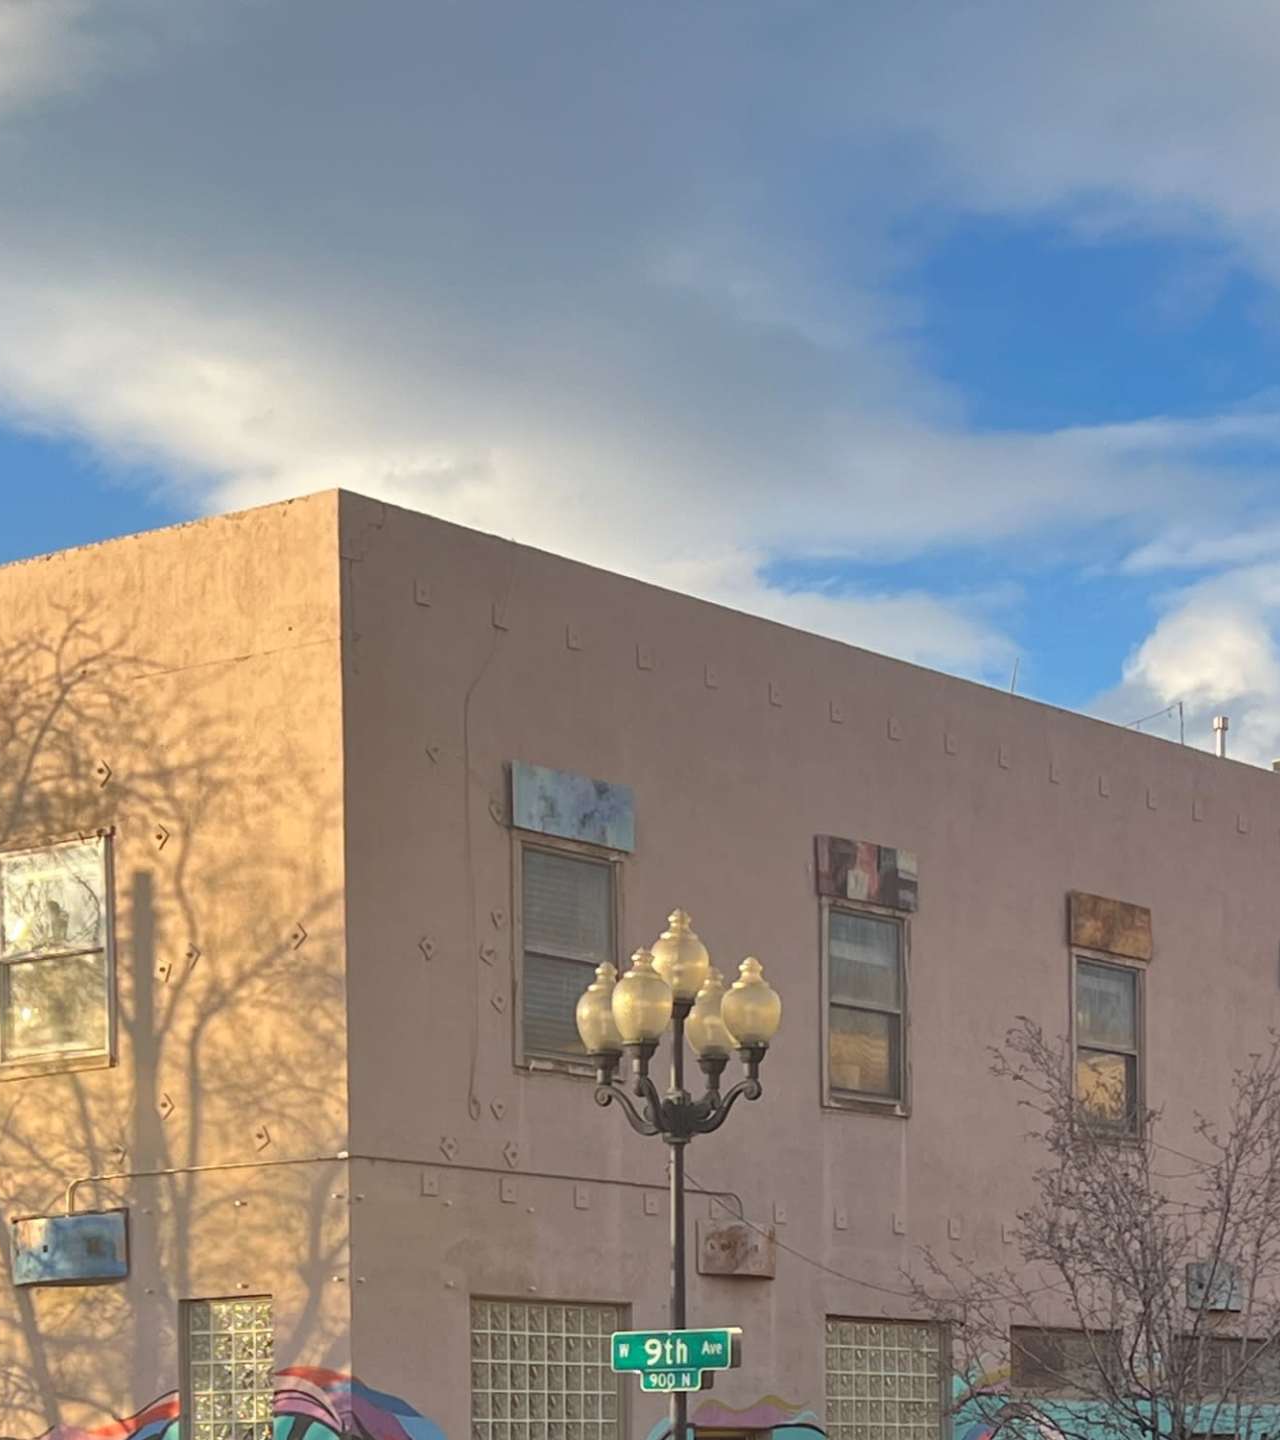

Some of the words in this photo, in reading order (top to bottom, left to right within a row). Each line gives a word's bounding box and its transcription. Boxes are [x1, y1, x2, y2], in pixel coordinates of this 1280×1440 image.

[619, 1343, 630, 1358] W
[644, 1338, 688, 1366] 9th
[701, 1340, 723, 1356] Ave
[649, 1373, 676, 1389] 900
[681, 1373, 691, 1387] N
